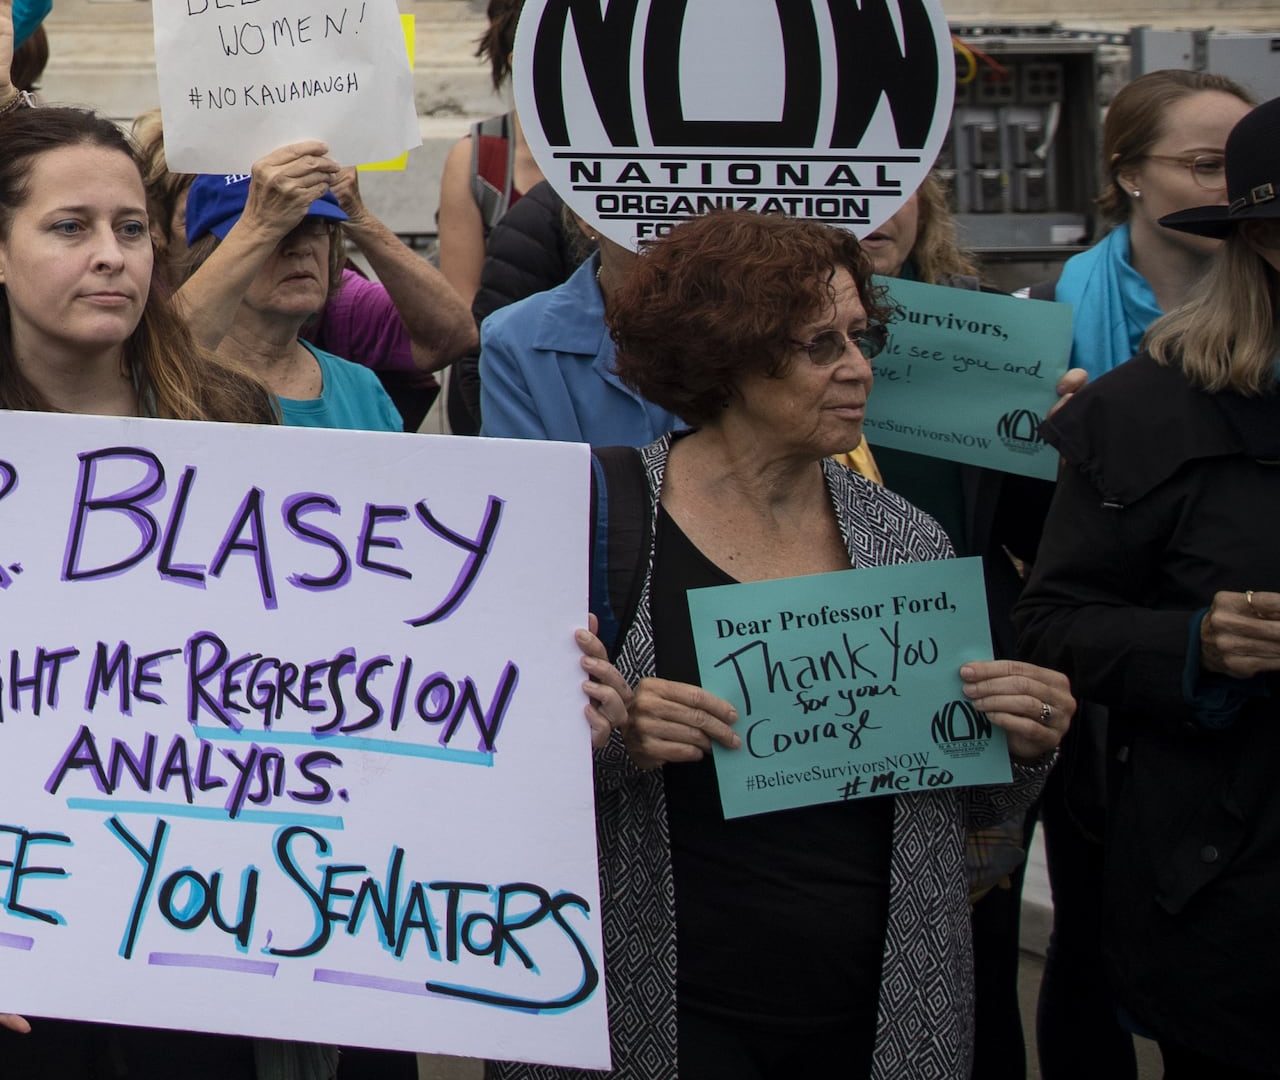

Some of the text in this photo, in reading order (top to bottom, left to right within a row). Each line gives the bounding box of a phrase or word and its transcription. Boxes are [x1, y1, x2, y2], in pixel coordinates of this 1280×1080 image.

[218, 1, 367, 57] WOMEN!
[569, 160, 902, 188] NATIONAL
[594, 193, 871, 219] ORGANIZATION
[636, 222, 678, 239] FO
[895, 303, 1009, 342] Survivors,
[907, 344, 946, 362] see
[952, 353, 1000, 374] you
[1003, 360, 1045, 380] and
[863, 418, 992, 450] eveSurvivorsNOW
[60, 445, 508, 630] BLASEY
[716, 591, 957, 639] Dear Professor Ford,
[87, 639, 184, 714] ME
[186, 629, 519, 752] REGRESSION
[713, 632, 878, 716] Thank
[792, 690, 831, 715] for
[745, 751, 931, 791] #BelieveSurvivorsNOW
